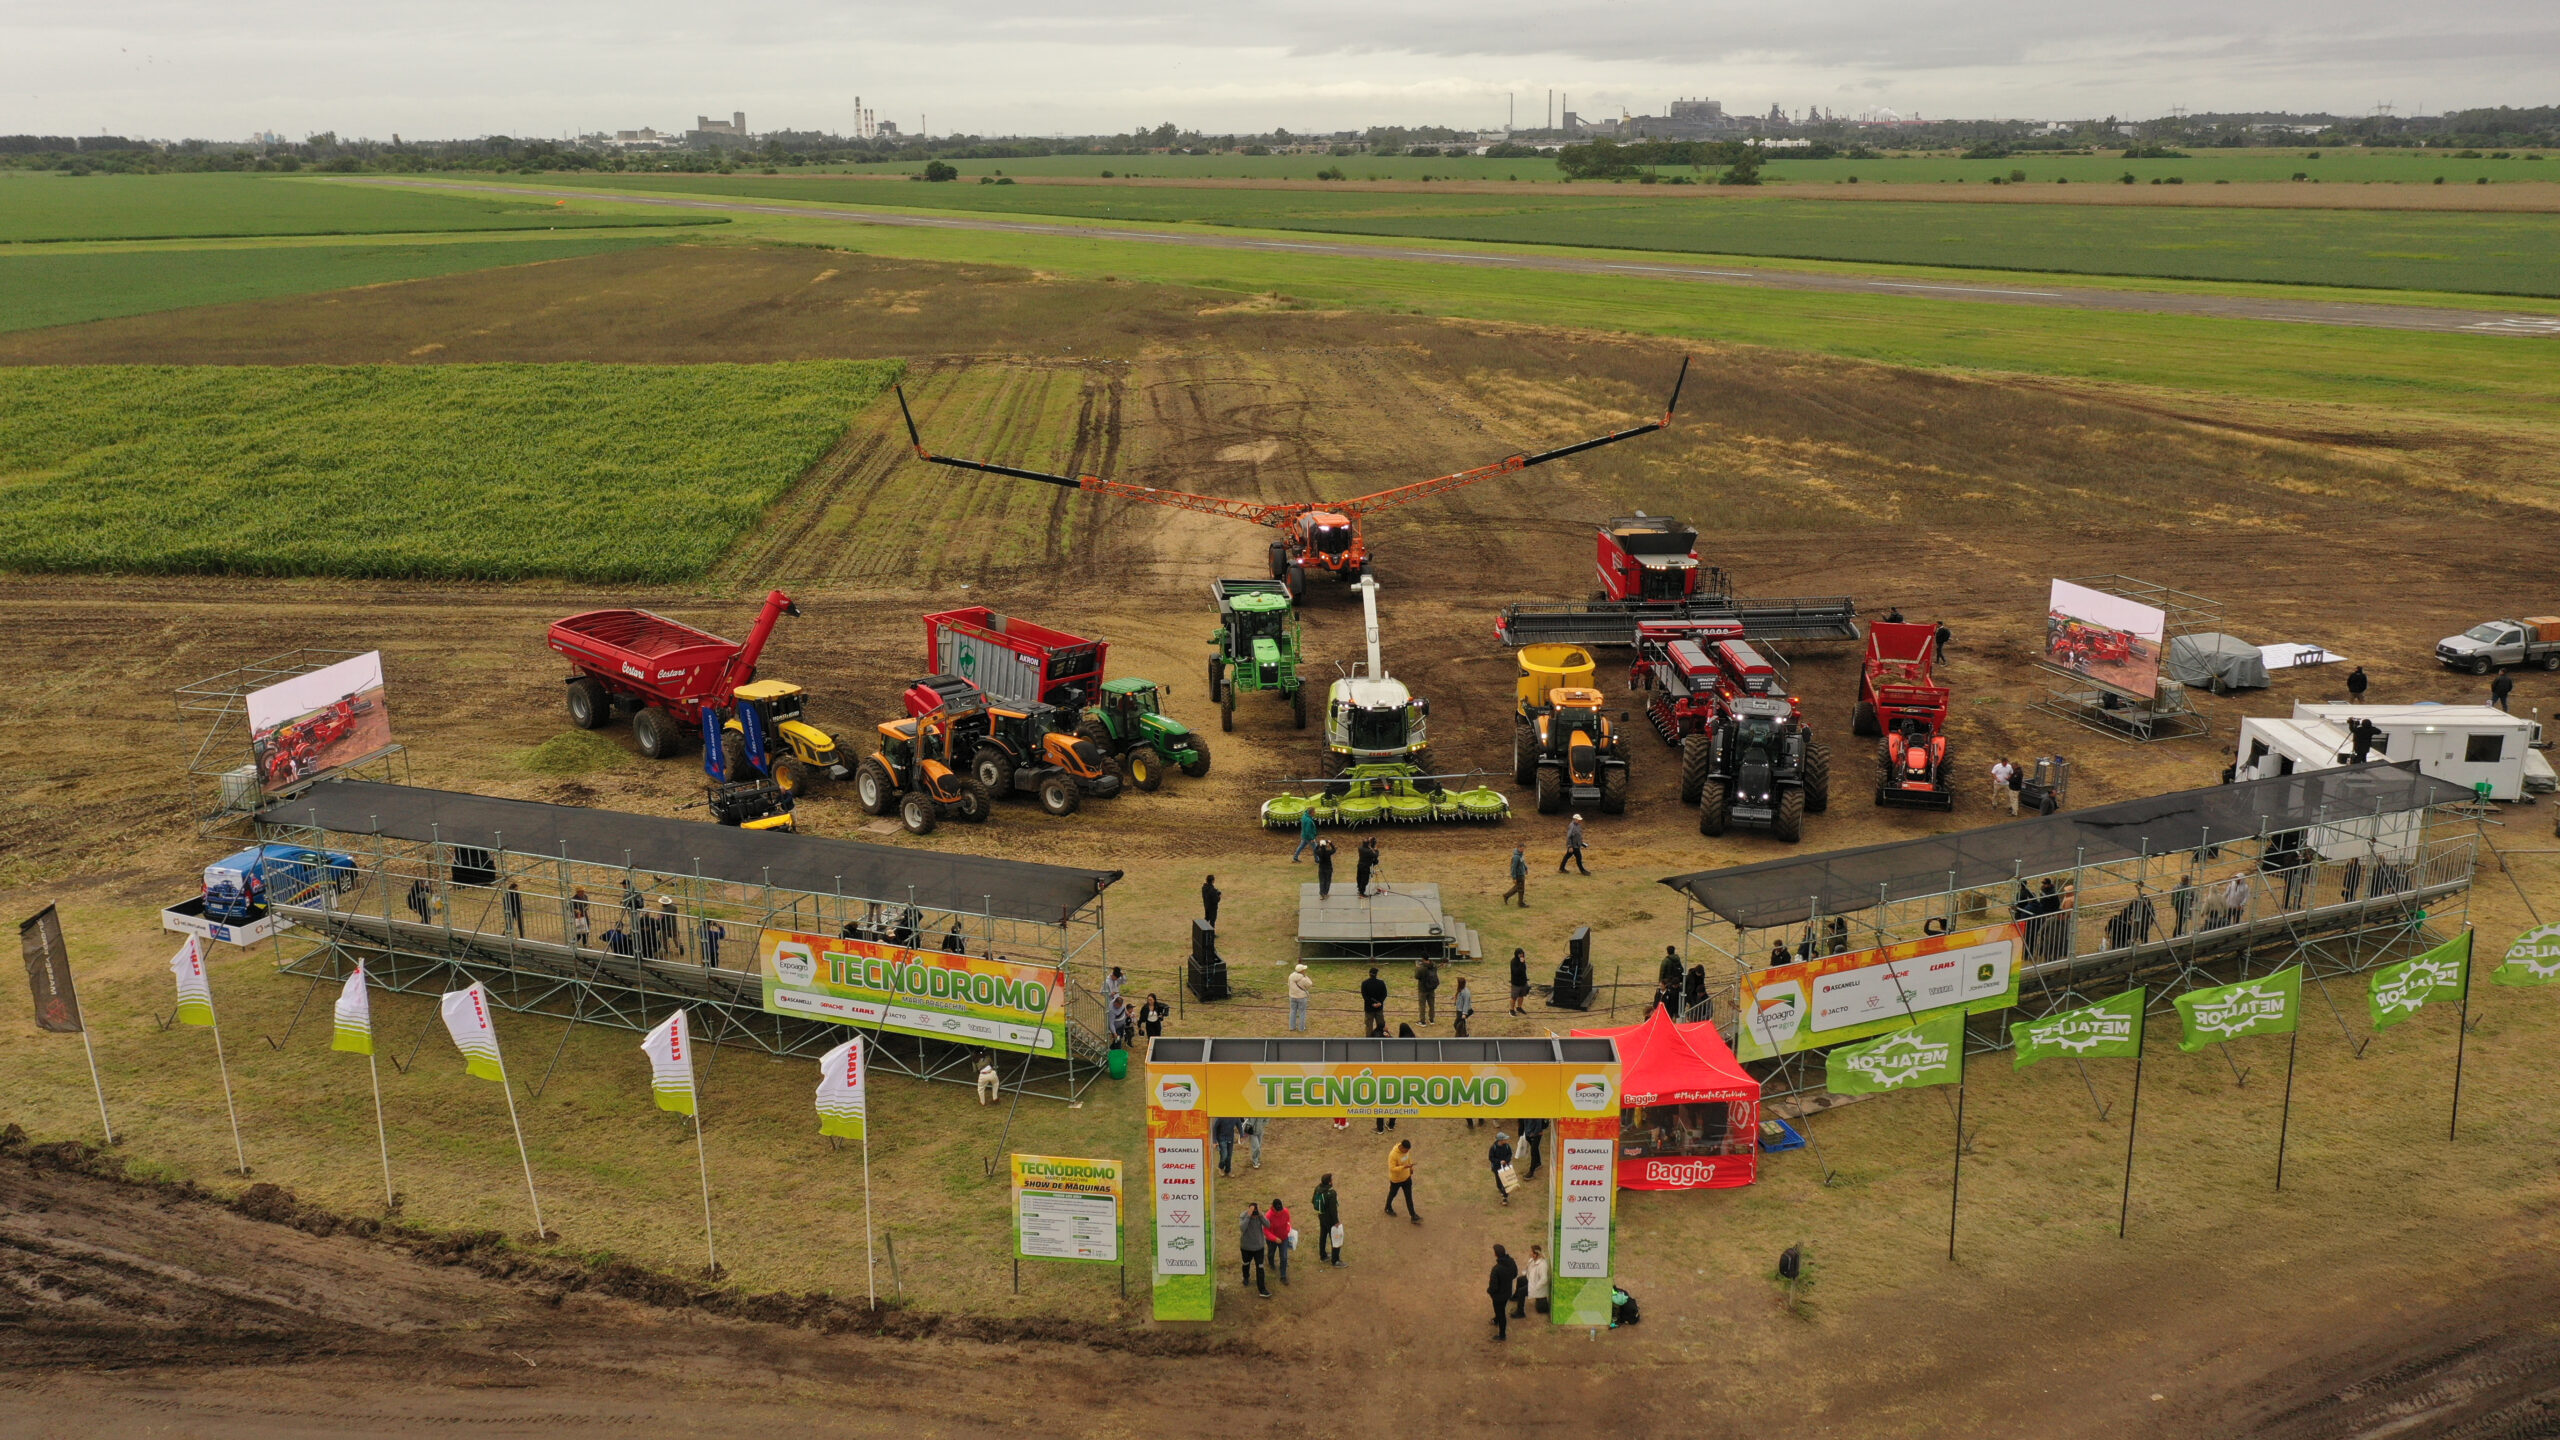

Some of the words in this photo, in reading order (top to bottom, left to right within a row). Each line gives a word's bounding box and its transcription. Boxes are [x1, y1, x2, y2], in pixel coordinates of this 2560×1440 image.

[1019, 654, 1039, 666] AKRON
[621, 661, 644, 680] Cestari
[657, 668, 686, 679] Cestari
[779, 961, 809, 972] Expoagro
[822, 950, 1047, 1013] TECNÓDROMO
[1830, 980, 1861, 991] ASCANELLI
[1929, 960, 1956, 971] CLAAS
[852, 1007, 875, 1015] CLAAS
[1756, 1009, 1795, 1025] Expoagro
[1828, 1006, 1849, 1015] JACTO
[1258, 1067, 1509, 1107] TECNÓDROMO
[1624, 1092, 1657, 1105] Baggio
[1346, 1107, 1372, 1115] MARIO
[1373, 1107, 1420, 1115] BRAGACHINI
[1018, 1162, 1115, 1180] TECNÓDROMO
[1647, 1161, 1715, 1186] Baggio
[1024, 1180, 1050, 1188] SHOW
